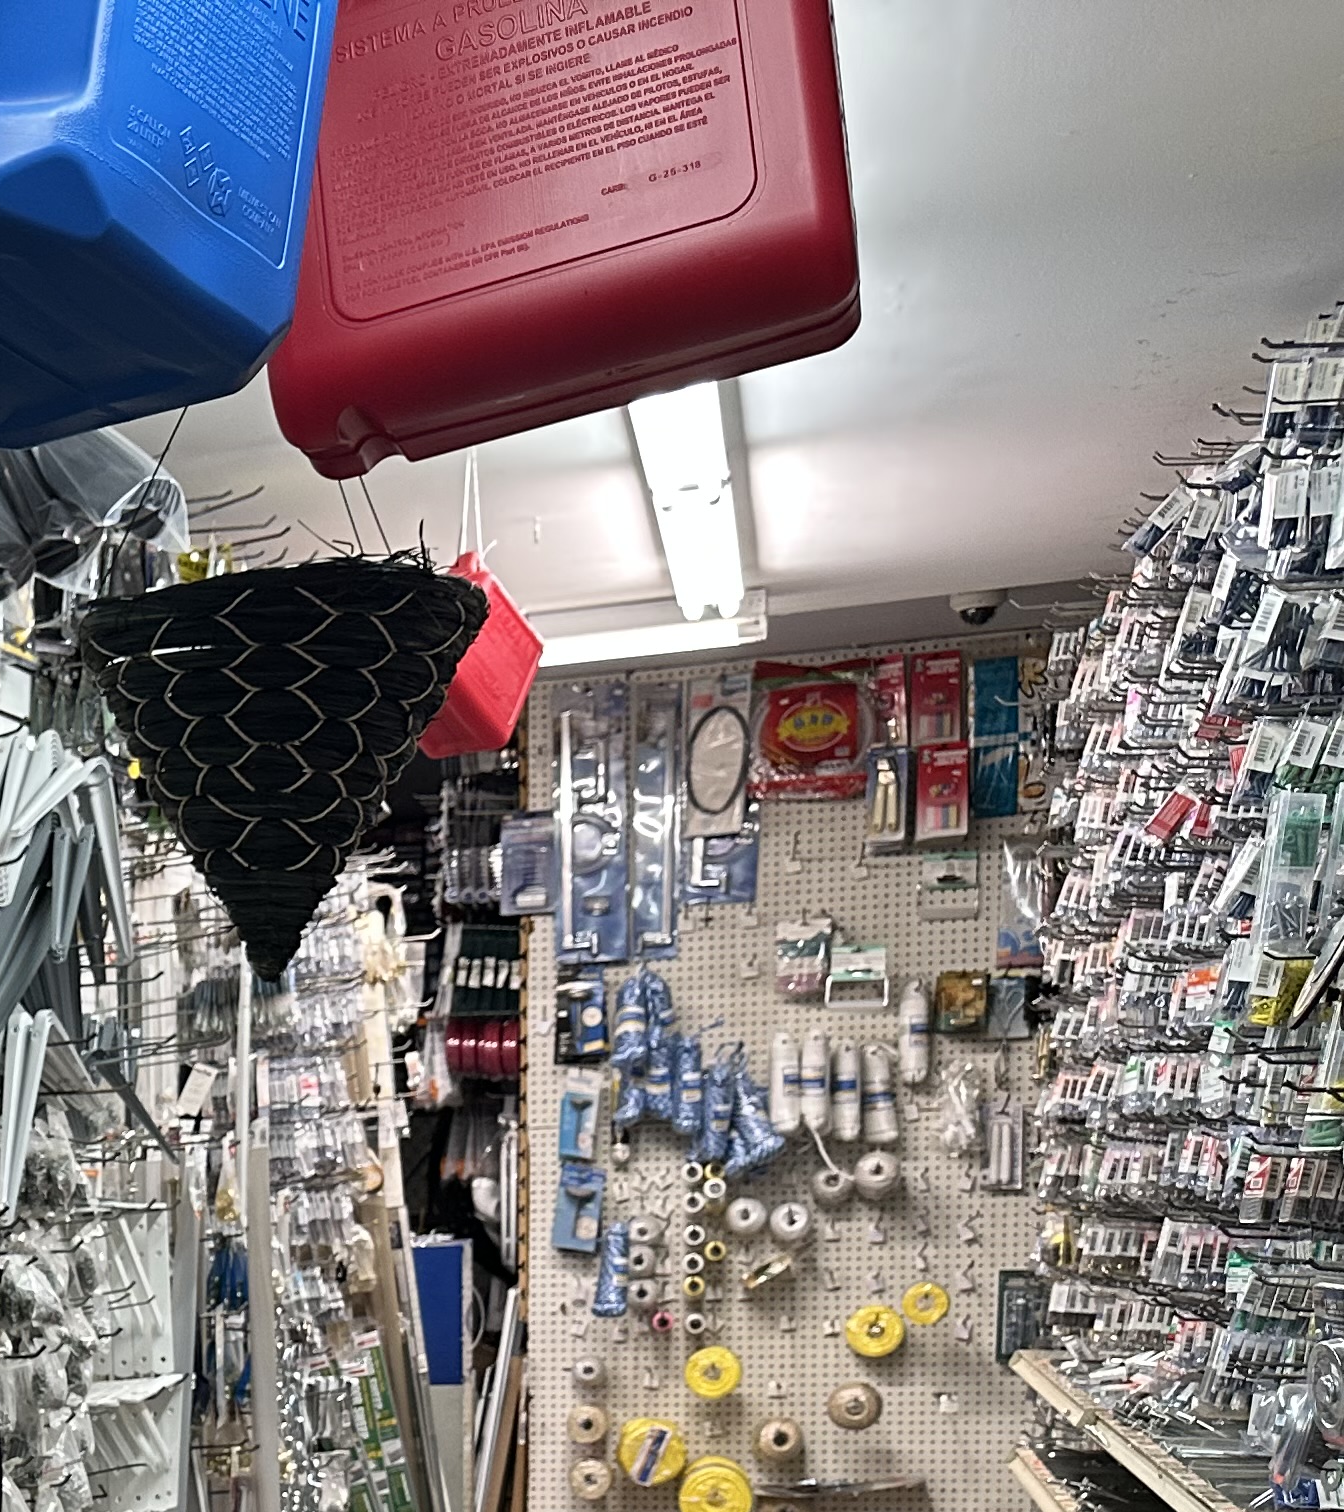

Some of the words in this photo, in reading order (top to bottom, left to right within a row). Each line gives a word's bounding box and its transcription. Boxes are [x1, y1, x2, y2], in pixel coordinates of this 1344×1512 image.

[436, 0, 588, 61] GASOLINA
[503, 44, 574, 75] EXPLOSIVOS
[588, 26, 634, 47] CAUSAR
[637, 6, 694, 34] INCENDIO
[565, 2, 652, 40] INFLAMABLE
[336, 23, 426, 63] SISTEMA
[544, 53, 592, 76] INGIERE
